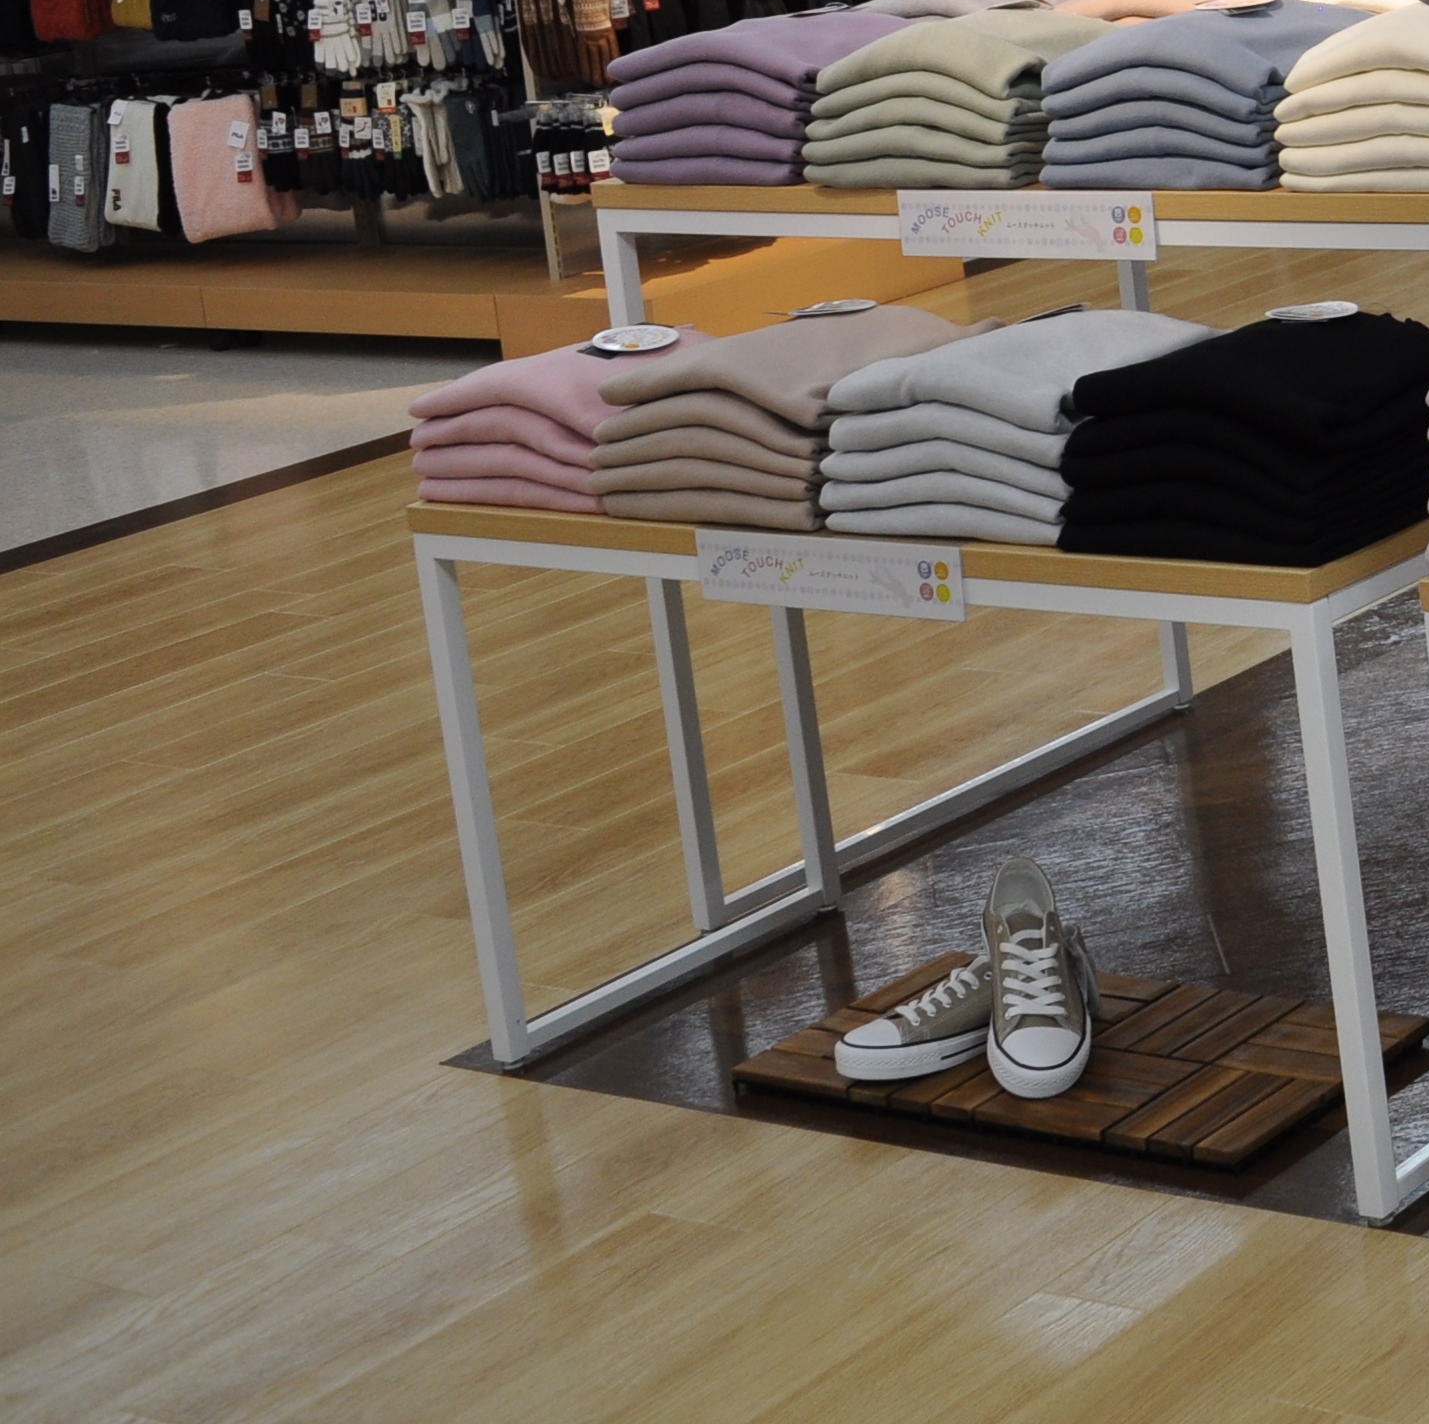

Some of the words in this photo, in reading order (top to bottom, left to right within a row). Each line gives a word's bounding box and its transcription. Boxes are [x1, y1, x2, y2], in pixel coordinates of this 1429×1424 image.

[911, 206, 950, 235] MOOSE
[942, 211, 982, 234] TOUCH
[977, 211, 1004, 238] KNIT
[710, 547, 750, 577] MOOSE
[742, 556, 784, 578] TOUCH
